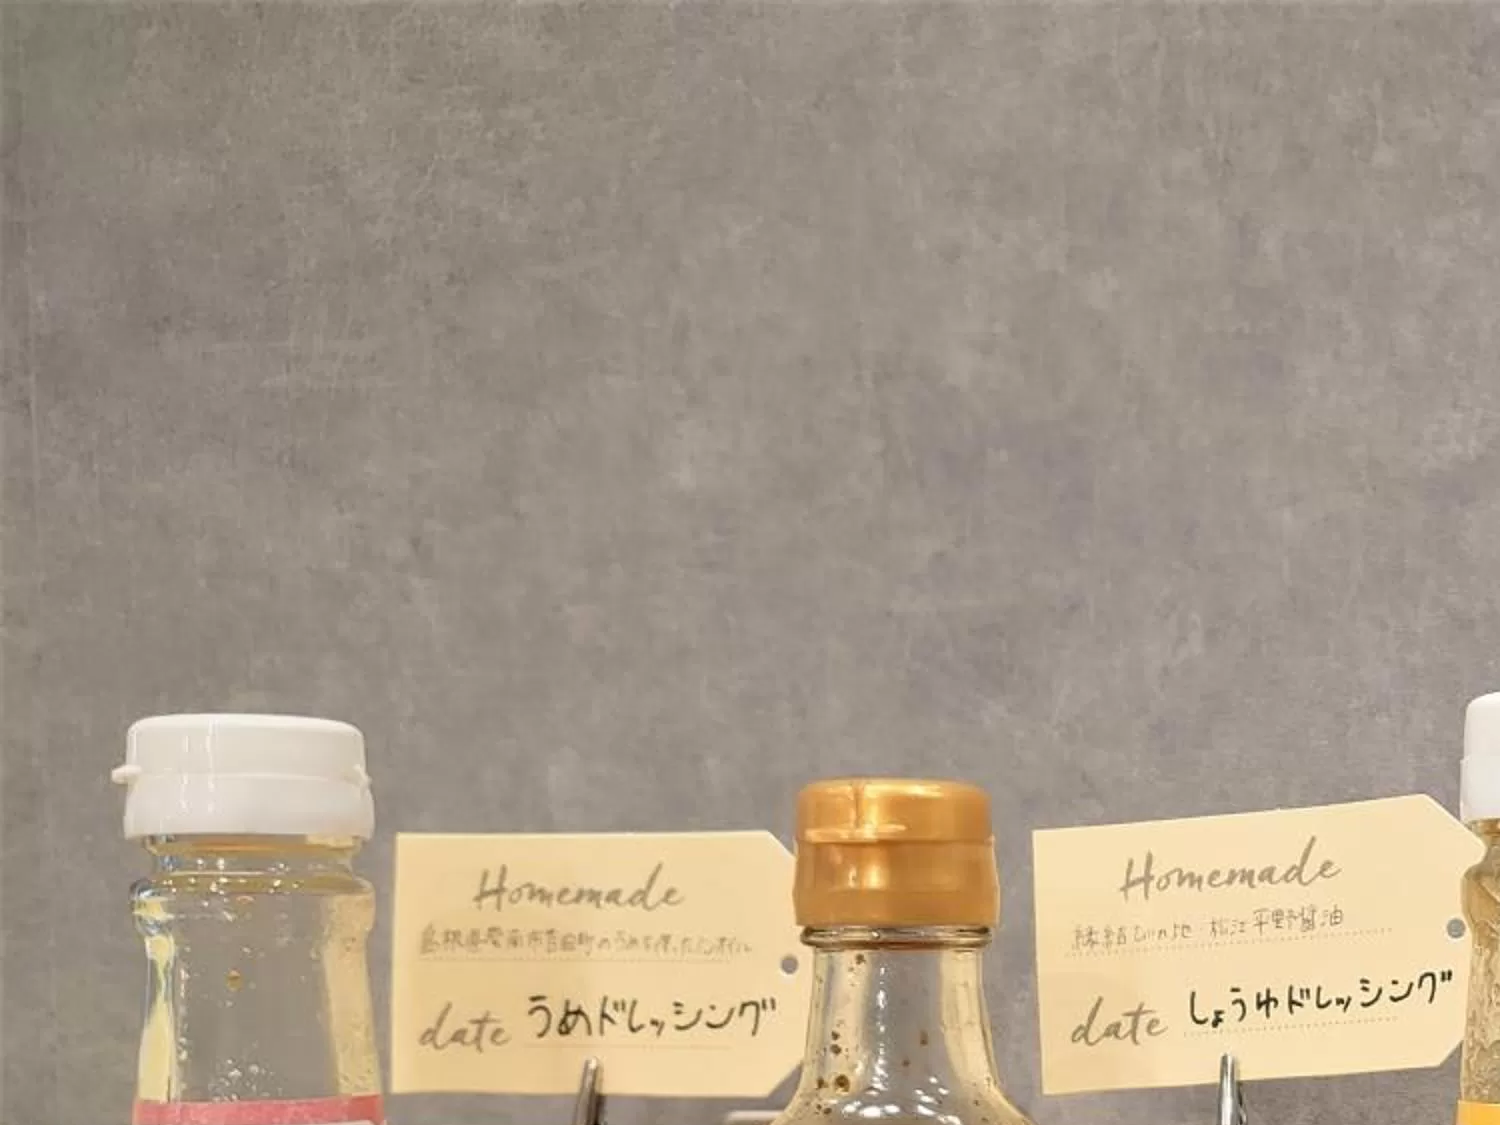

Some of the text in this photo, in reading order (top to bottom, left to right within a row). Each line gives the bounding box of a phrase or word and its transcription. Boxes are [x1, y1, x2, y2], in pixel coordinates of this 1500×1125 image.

[473, 862, 686, 912] Homemade
[1120, 836, 1341, 900] Homemade
[528, 995, 777, 1038] うめドレッシング
[1071, 996, 1168, 1047] date
[1189, 970, 1453, 1029] しょうゆドレッシング
[418, 1002, 513, 1054] date
